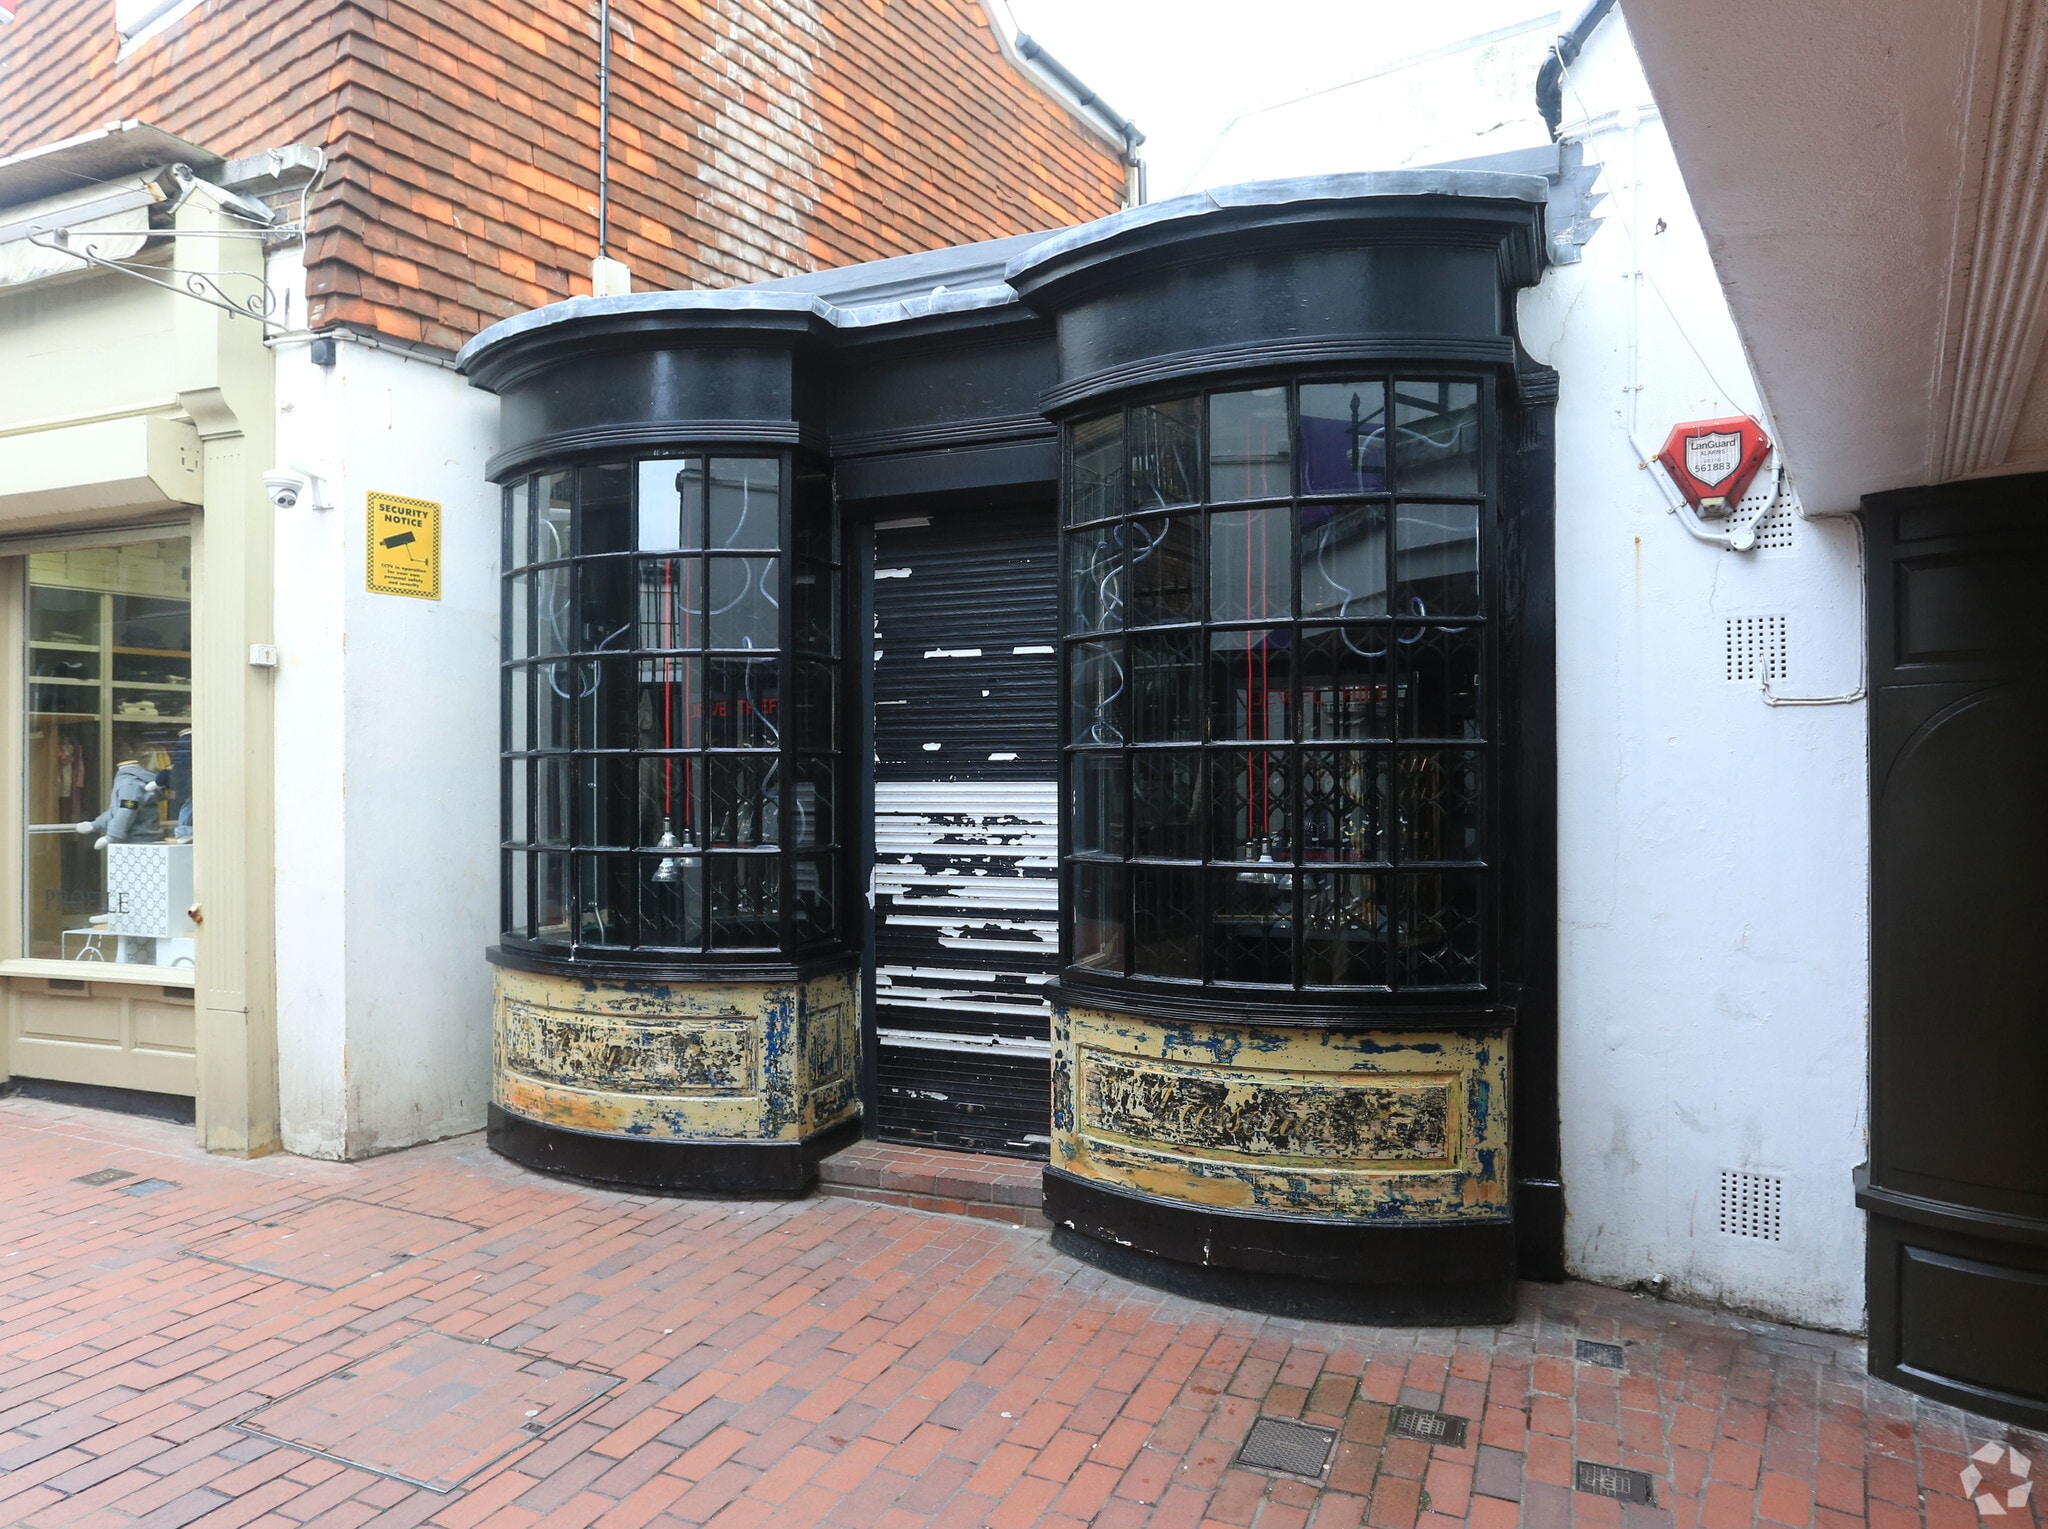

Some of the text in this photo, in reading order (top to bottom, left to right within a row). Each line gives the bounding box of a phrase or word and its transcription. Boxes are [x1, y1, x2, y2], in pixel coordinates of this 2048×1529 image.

[1691, 439, 1736, 450] LanGuard
[1695, 462, 1731, 472] 561883
[379, 504, 428, 519] SECURITY
[385, 515, 422, 527] NOTICE
